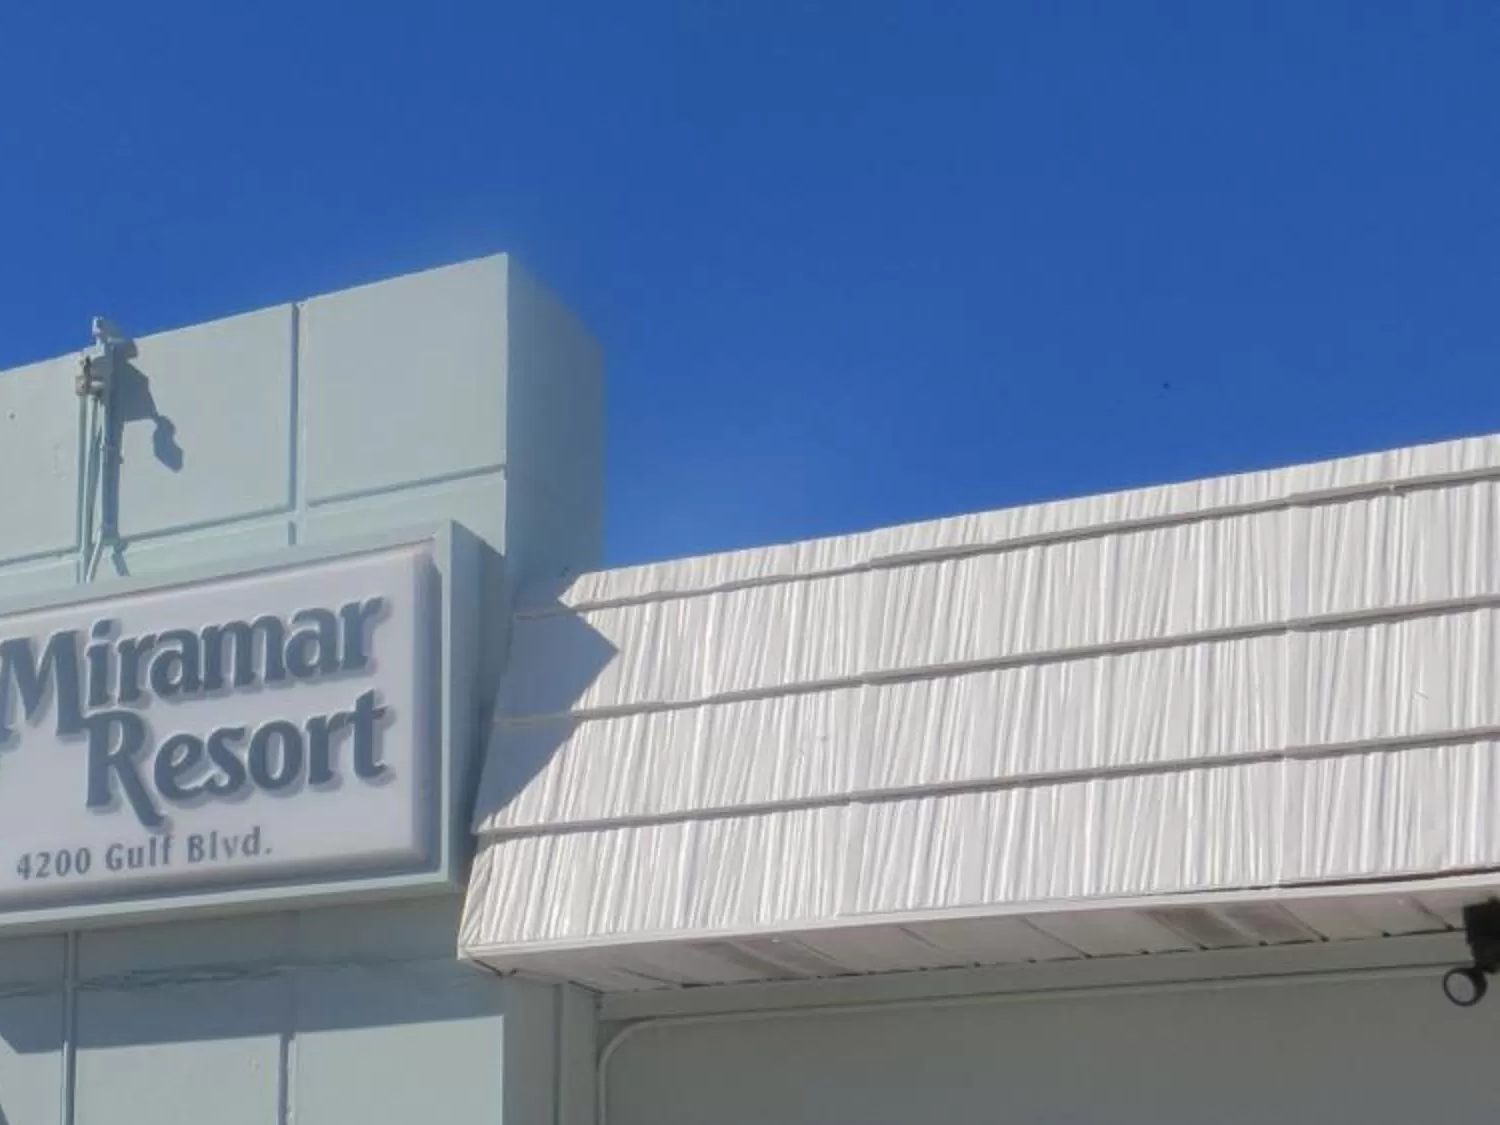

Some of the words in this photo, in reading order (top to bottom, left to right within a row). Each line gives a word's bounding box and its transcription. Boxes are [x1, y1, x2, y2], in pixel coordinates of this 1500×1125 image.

[83, 688, 390, 829] Resort
[16, 847, 92, 880] 4200
[105, 833, 175, 871] Gulf
[186, 826, 273, 864] Blvd.
